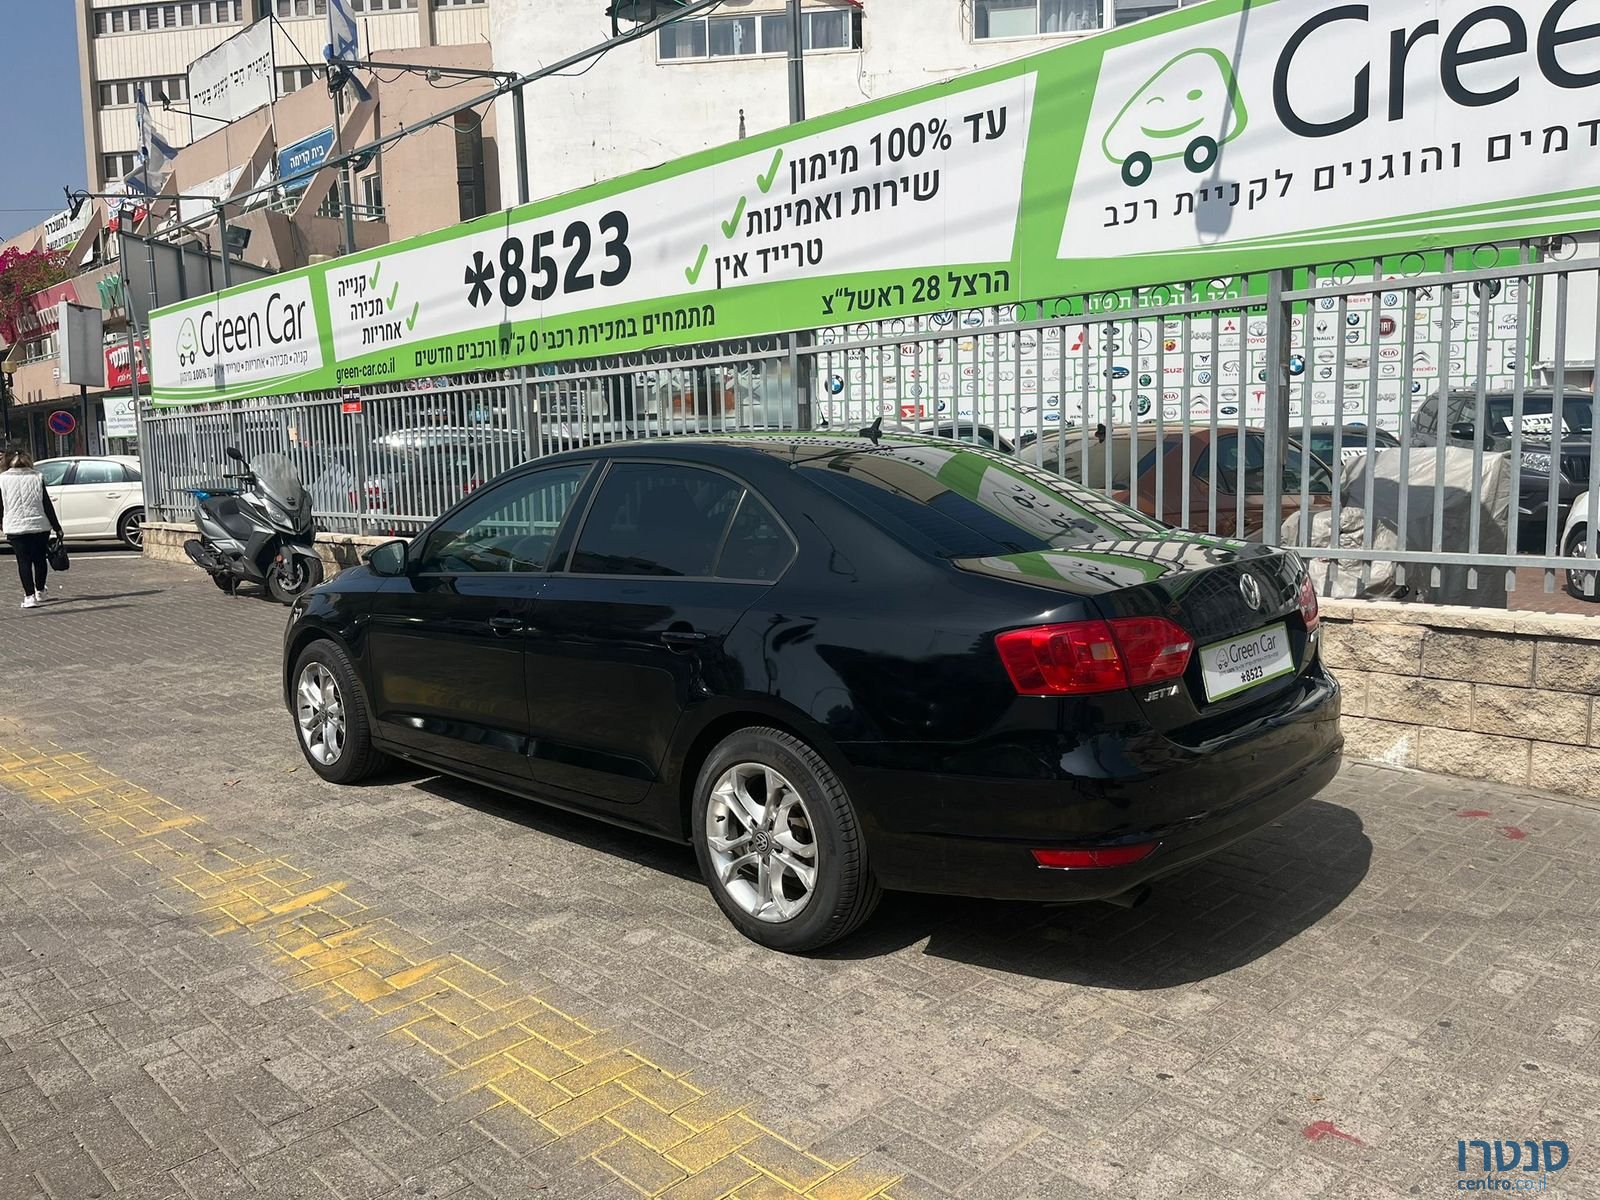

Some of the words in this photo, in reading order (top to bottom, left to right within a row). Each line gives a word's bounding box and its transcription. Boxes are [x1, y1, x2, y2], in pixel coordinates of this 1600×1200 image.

[963, 106, 1007, 143] עד
[290, 150, 310, 169] קדימה
[311, 145, 324, 159] בית
[870, 118, 952, 174] 100%
[789, 145, 858, 194] מימון
[1314, 141, 1461, 192] והוגנים
[851, 169, 940, 215] שירות
[1173, 168, 1293, 215] לקניית
[746, 192, 841, 238] ואמינות
[1103, 198, 1158, 228] רכב
[756, 238, 823, 273] טרייד
[715, 252, 748, 290] אין
[948, 269, 1009, 299] הרצל
[338, 275, 366, 298] קנייה
[911, 275, 941, 303] 28
[350, 298, 383, 320] מכירה
[643, 304, 715, 334] מתמחים
[200, 310, 262, 358] Green
[266, 293, 306, 345] Car
[362, 320, 402, 344] אחריות
[542, 326, 574, 350] רכבי
[578, 317, 636, 346] במכירת
[1380, 321, 1391, 332] IAT
[457, 339, 496, 362] ורכבים
[529, 329, 539, 352] 0
[244, 357, 265, 372] אחריות
[270, 353, 289, 367] מכירה
[294, 350, 308, 366] קניה
[336, 356, 395, 383] green-car.co.il
[415, 345, 453, 367] חדשים
[192, 368, 207, 381] 100%
[1229, 642, 1260, 664] Green
[1260, 633, 1276, 653] Car
[1144, 685, 1179, 702] JETTA
